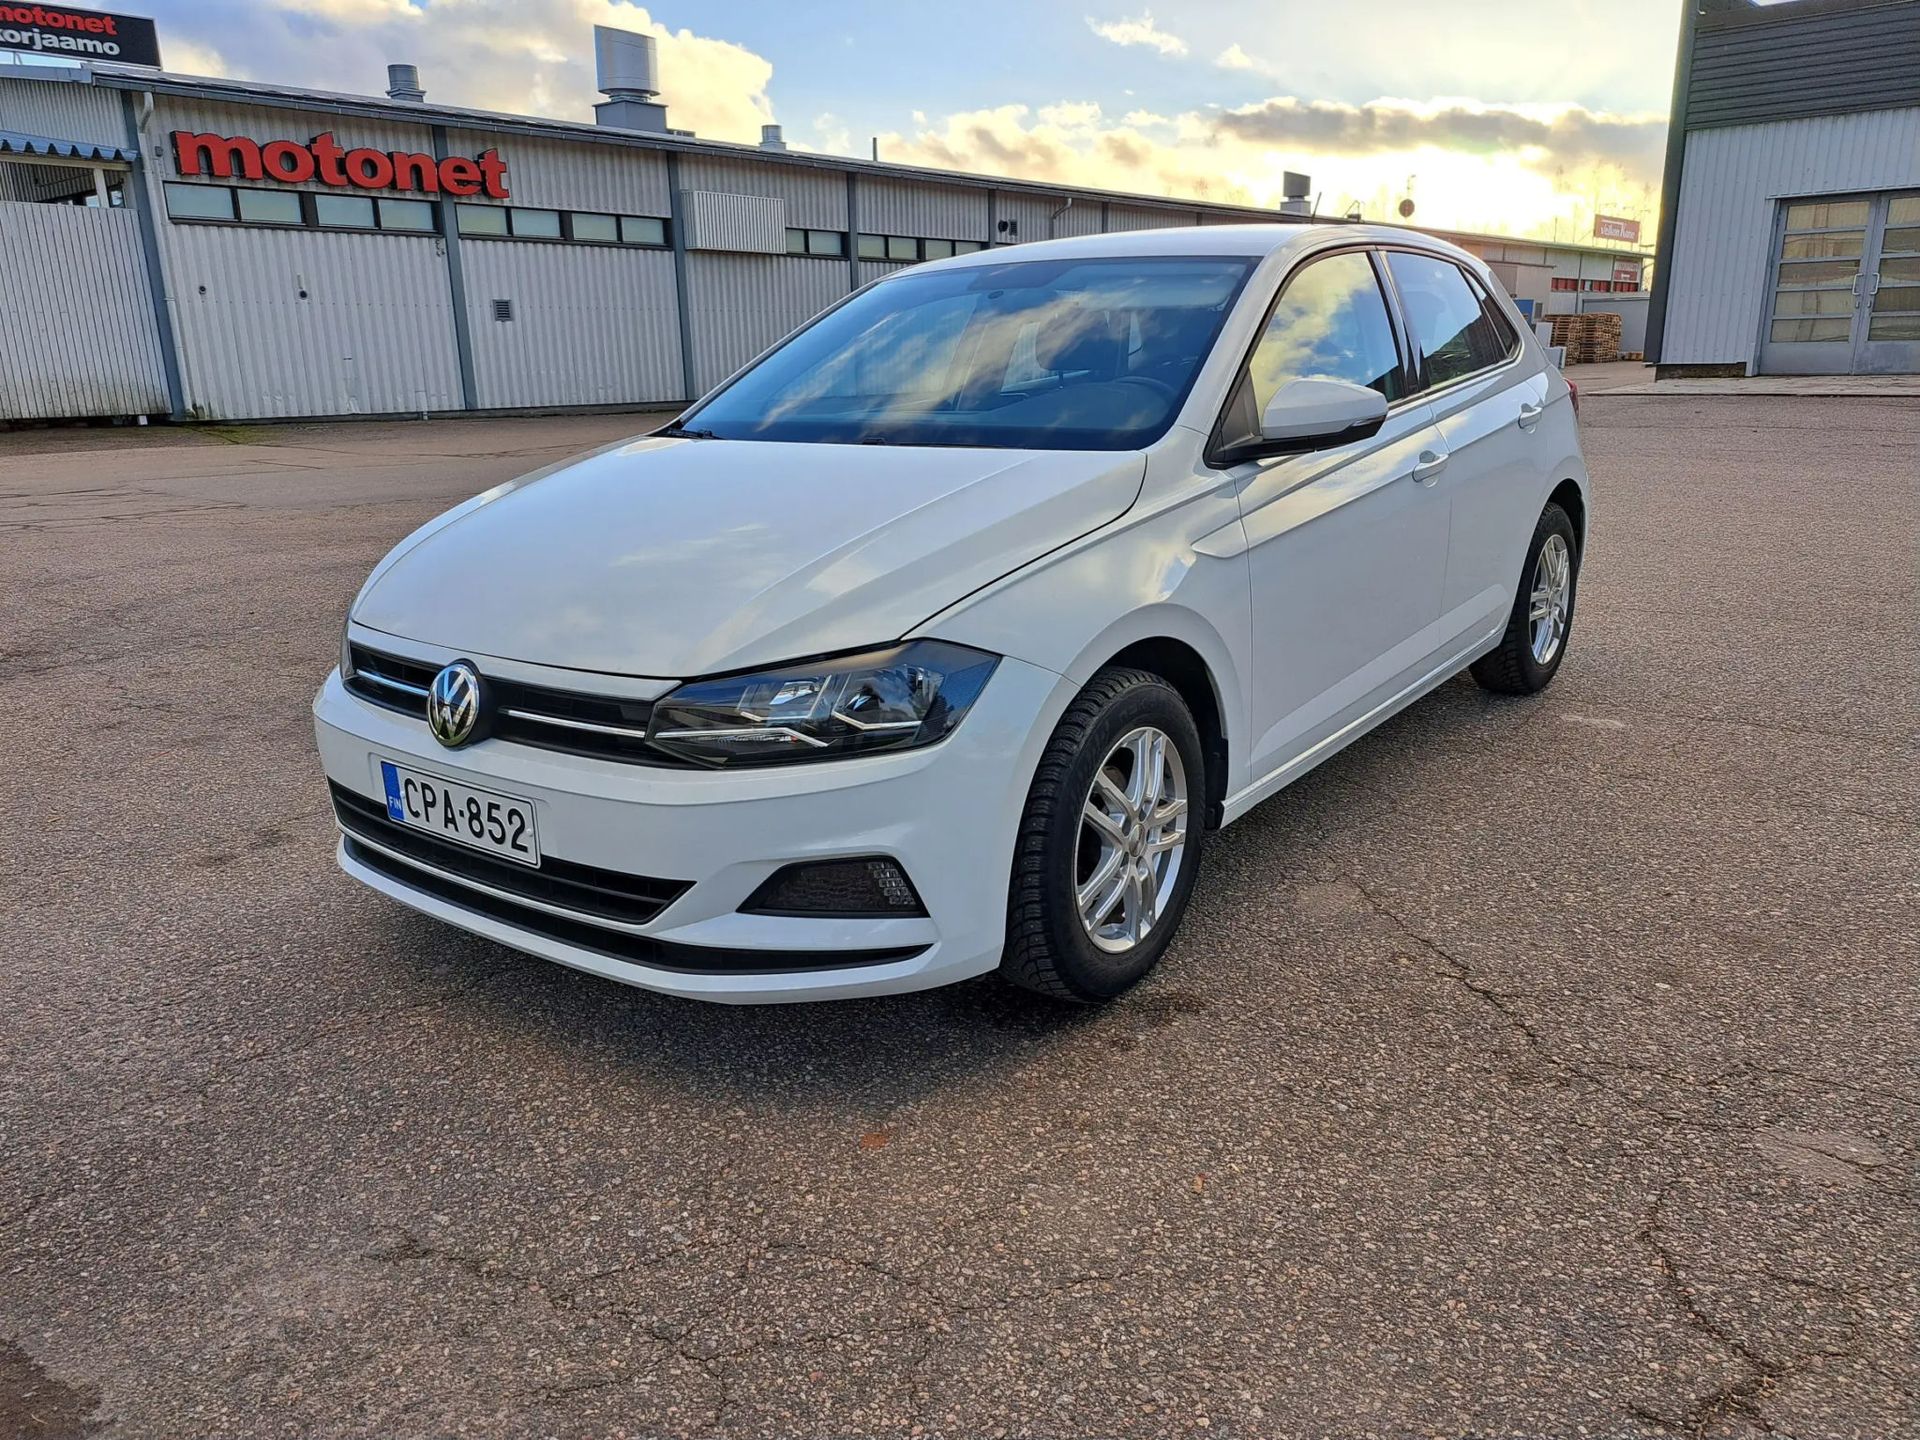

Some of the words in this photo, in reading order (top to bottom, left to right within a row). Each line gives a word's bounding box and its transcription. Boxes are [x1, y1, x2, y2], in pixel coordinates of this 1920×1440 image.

[0, 28, 121, 56] orjaamo
[170, 131, 510, 199] motonet
[388, 795, 403, 811] FIN
[404, 777, 529, 853] CPA-852
